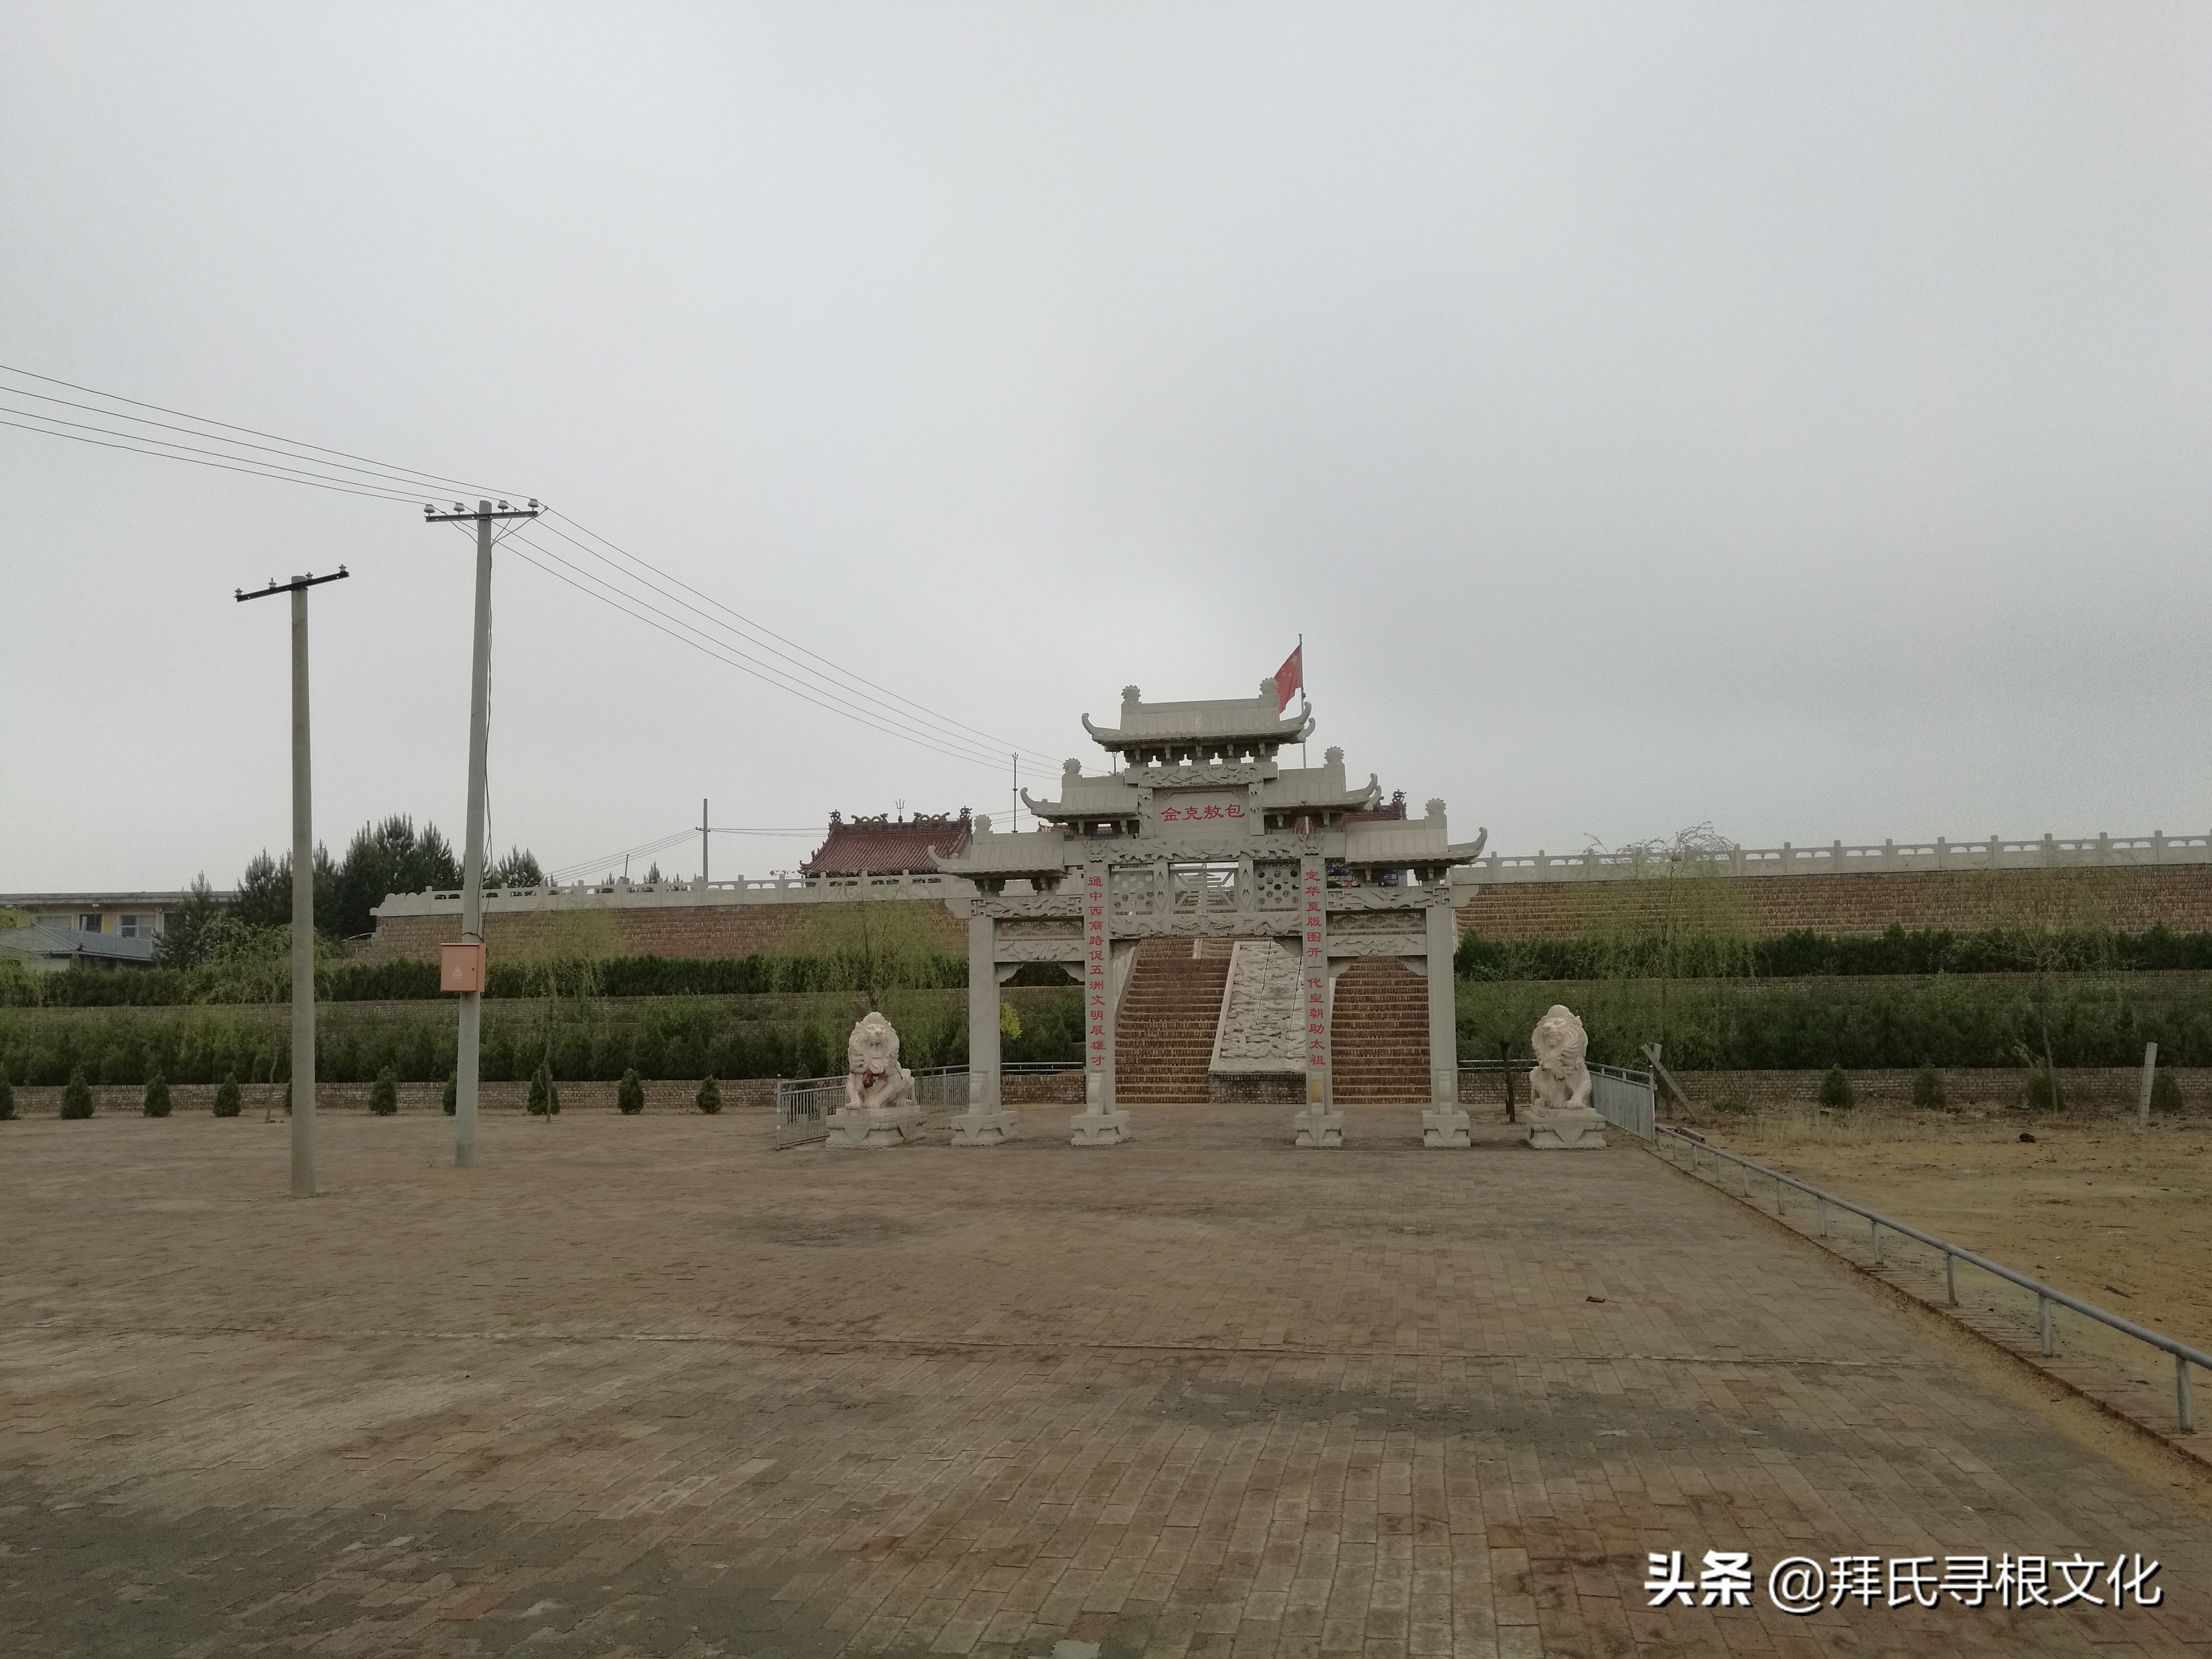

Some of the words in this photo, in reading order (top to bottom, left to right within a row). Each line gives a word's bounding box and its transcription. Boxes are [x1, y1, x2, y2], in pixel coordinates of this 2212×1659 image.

[1161, 804, 1245, 822] 金克敖包
[1088, 876, 1106, 1066] 通中西商路促五洲文明展雄才
[1305, 871, 1325, 1065] 定华夏版图开一代皇朝助太祖
